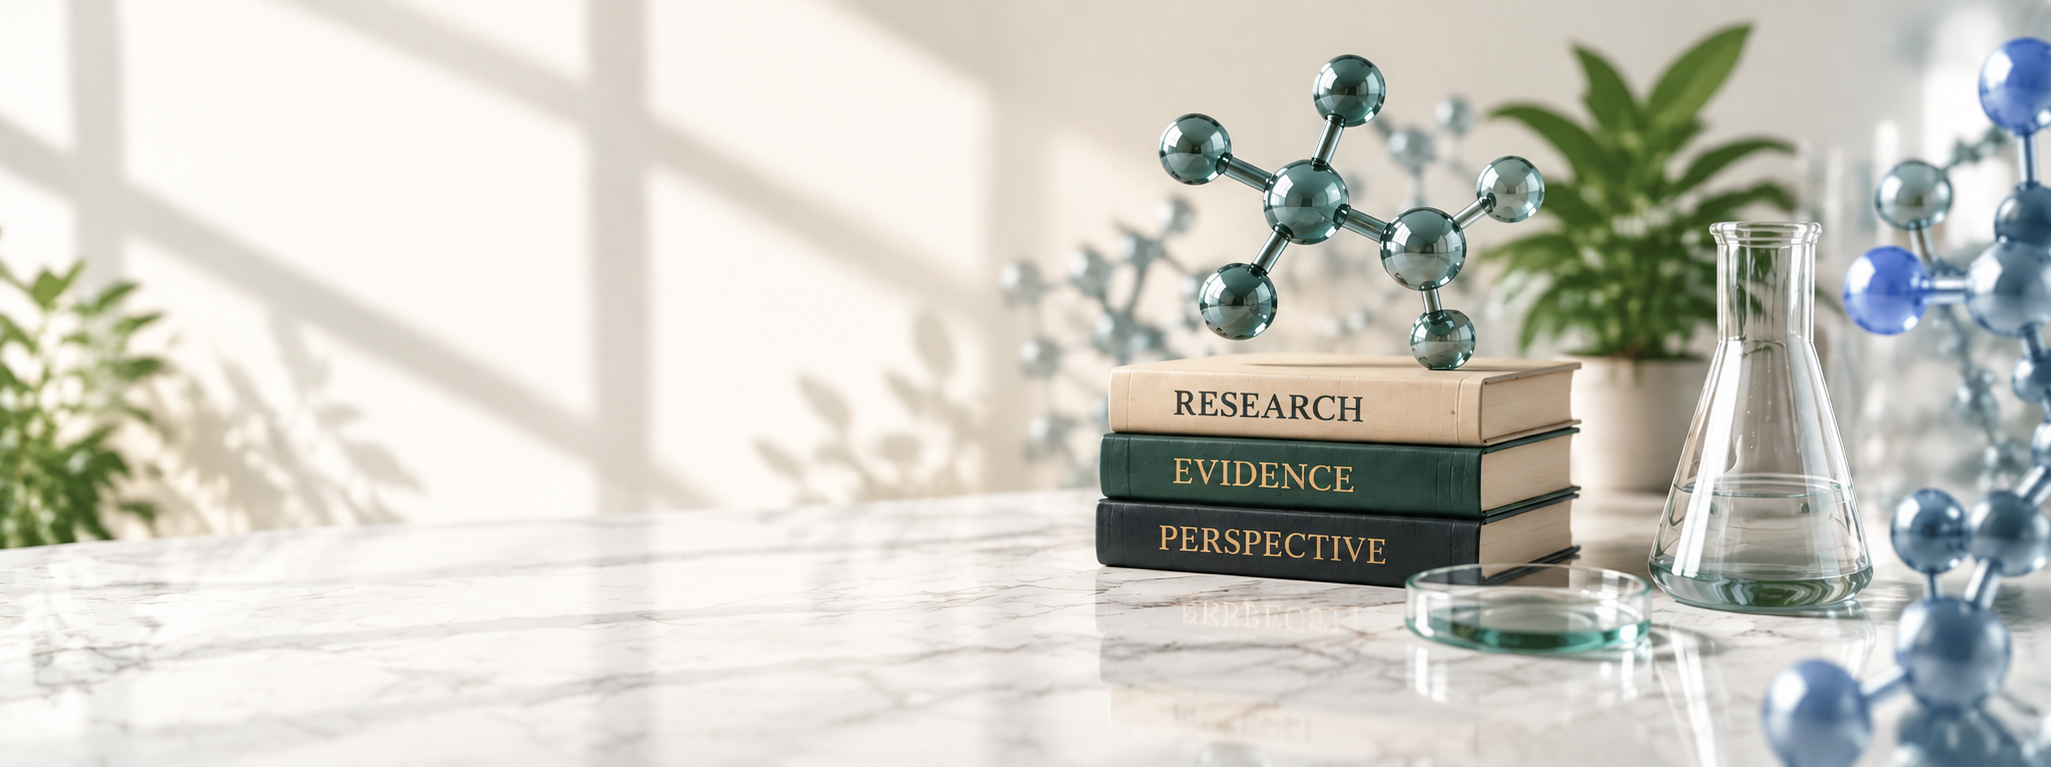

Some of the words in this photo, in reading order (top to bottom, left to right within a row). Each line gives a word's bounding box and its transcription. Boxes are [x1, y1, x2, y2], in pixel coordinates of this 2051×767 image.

[1173, 389, 1364, 423] RESEARCH
[1172, 457, 1355, 493] EVIDENCE
[1158, 524, 1387, 565] PERSPECTIVE
